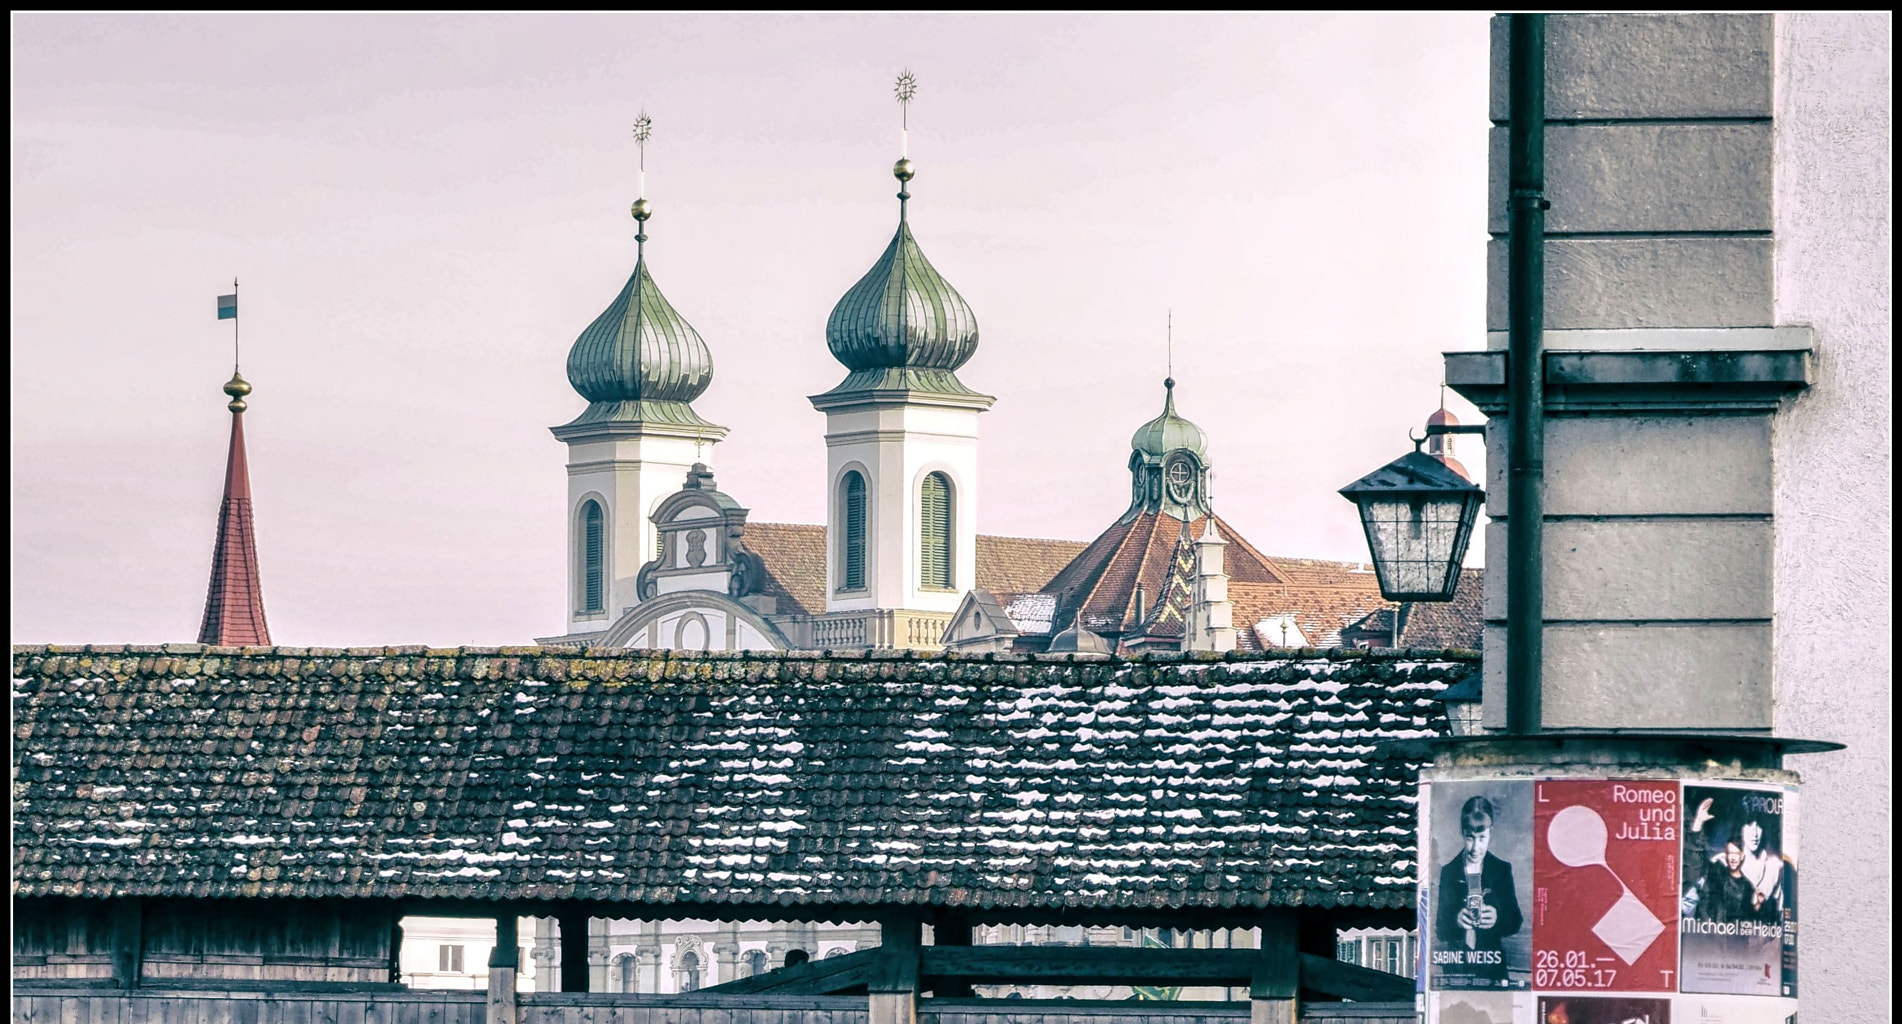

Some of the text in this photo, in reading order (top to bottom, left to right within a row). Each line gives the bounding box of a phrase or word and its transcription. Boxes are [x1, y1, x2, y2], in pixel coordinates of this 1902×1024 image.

[1539, 785, 1550, 802] L
[1613, 785, 1676, 803] Romeo
[1640, 804, 1676, 822] und
[1615, 822, 1676, 840] Julia
[1682, 917, 1739, 936] Michael
[1753, 920, 1782, 938] Heide
[1433, 950, 1502, 964] SABINE WEISS
[1536, 969, 1617, 988] 07.05.17
[1660, 971, 1674, 988] T
